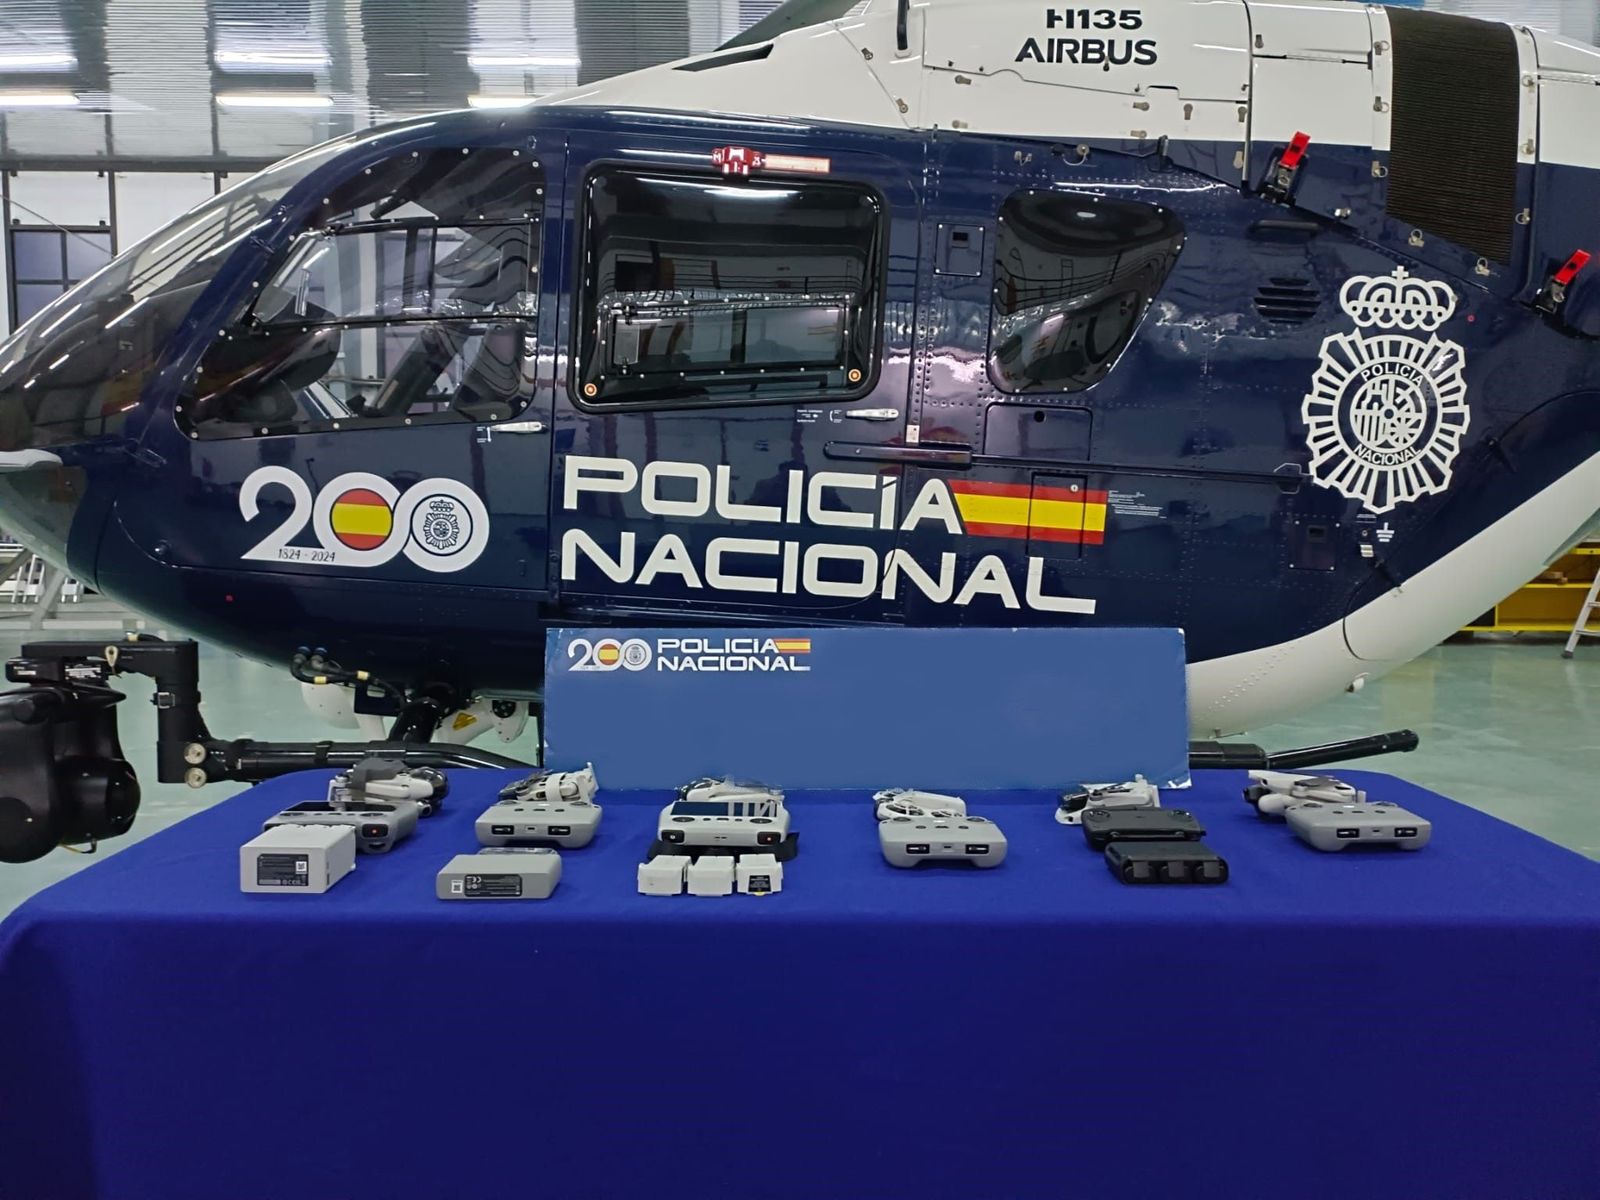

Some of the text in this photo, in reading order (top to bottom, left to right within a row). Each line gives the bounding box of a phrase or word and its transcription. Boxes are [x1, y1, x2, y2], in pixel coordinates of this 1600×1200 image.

[1046, 9, 1143, 30] H135
[1015, 38, 1157, 65] AIRBUS
[1361, 363, 1423, 387] POLICIA
[1354, 444, 1421, 465] NACIONAL
[240, 466, 490, 573] 200
[279, 549, 300, 559] 1824
[311, 551, 335, 562] 2024
[561, 528, 1096, 614] NACIONAL
[567, 638, 652, 671] 200
[657, 656, 811, 671] NACIONAL
